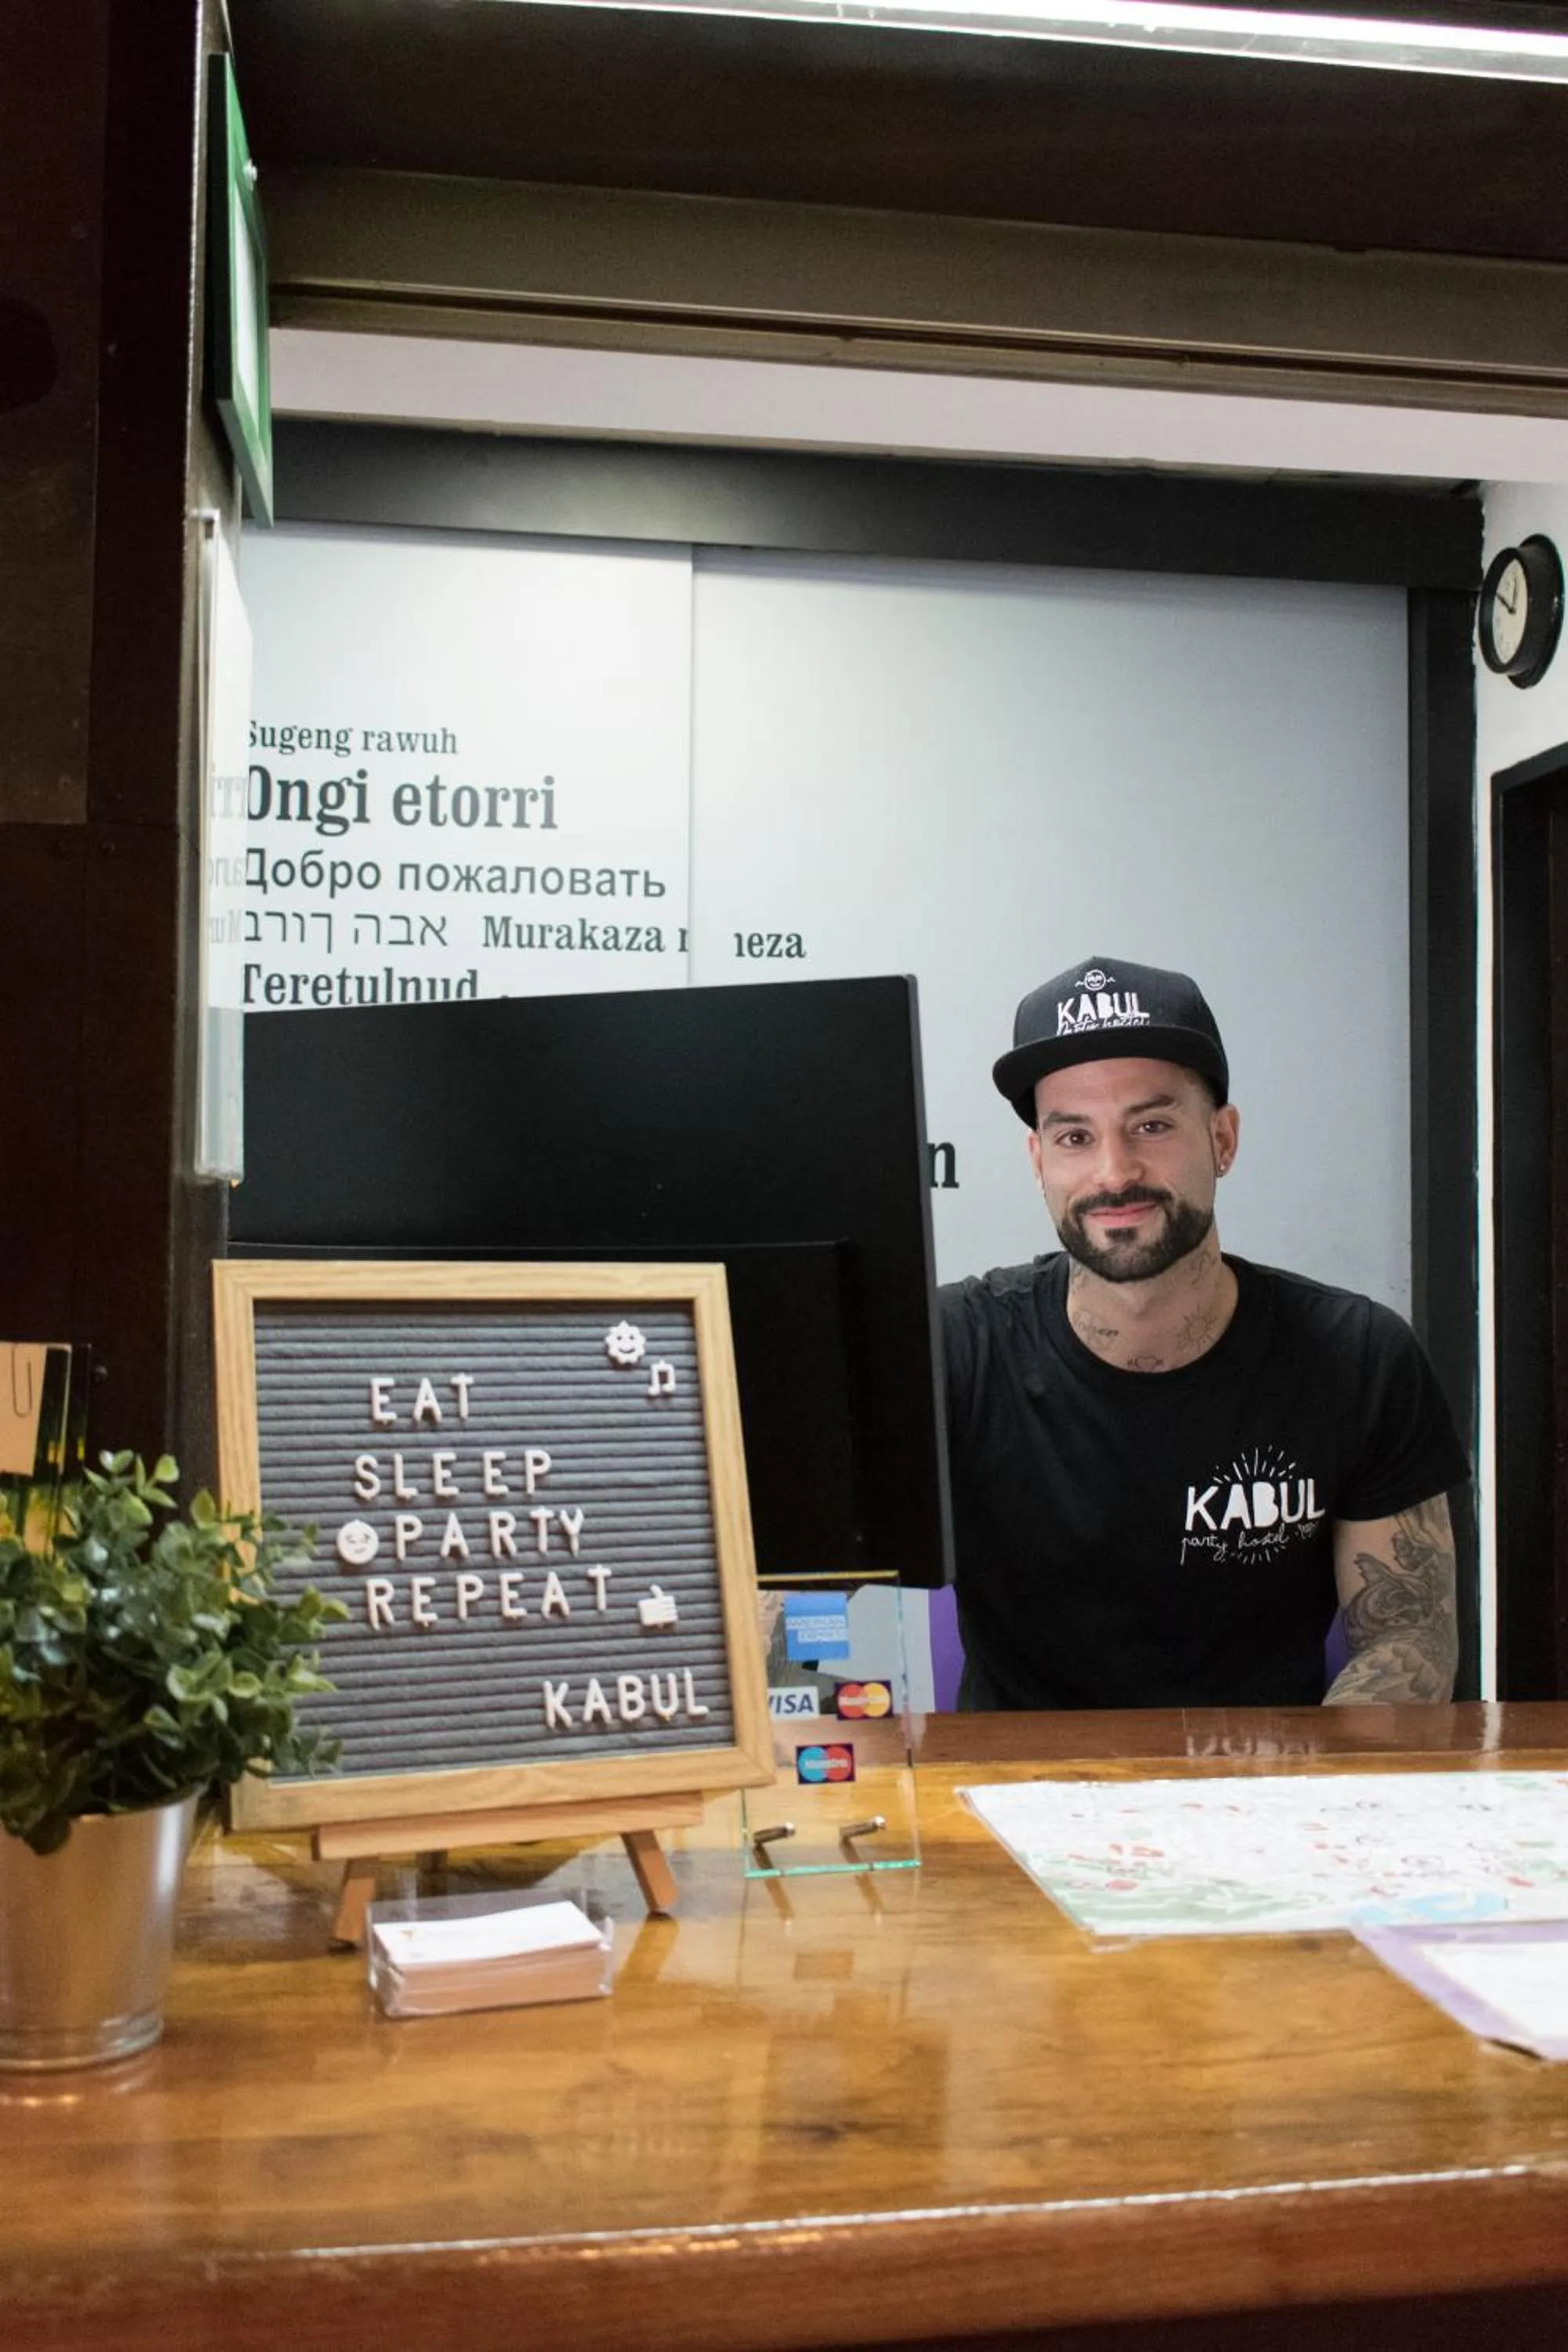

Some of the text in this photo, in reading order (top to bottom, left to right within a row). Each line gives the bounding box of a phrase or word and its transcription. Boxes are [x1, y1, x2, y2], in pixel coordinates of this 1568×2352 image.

[361, 728, 458, 755] rawuh
[248, 764, 371, 837] Ongi
[392, 774, 558, 829] etorri
[245, 847, 382, 899] Добро
[398, 862, 666, 898] пожаловать
[482, 914, 666, 953] Murakaza
[1056, 991, 1150, 1025] KABUL
[370, 1373, 474, 1422] EAT
[354, 1448, 552, 1500] SLEEP
[1185, 1478, 1326, 1531] KABUL
[395, 1506, 585, 1560] PARTY
[1180, 1533, 1229, 1566] party
[366, 1564, 612, 1628] REPEAT
[543, 1668, 709, 1728] KABUL
